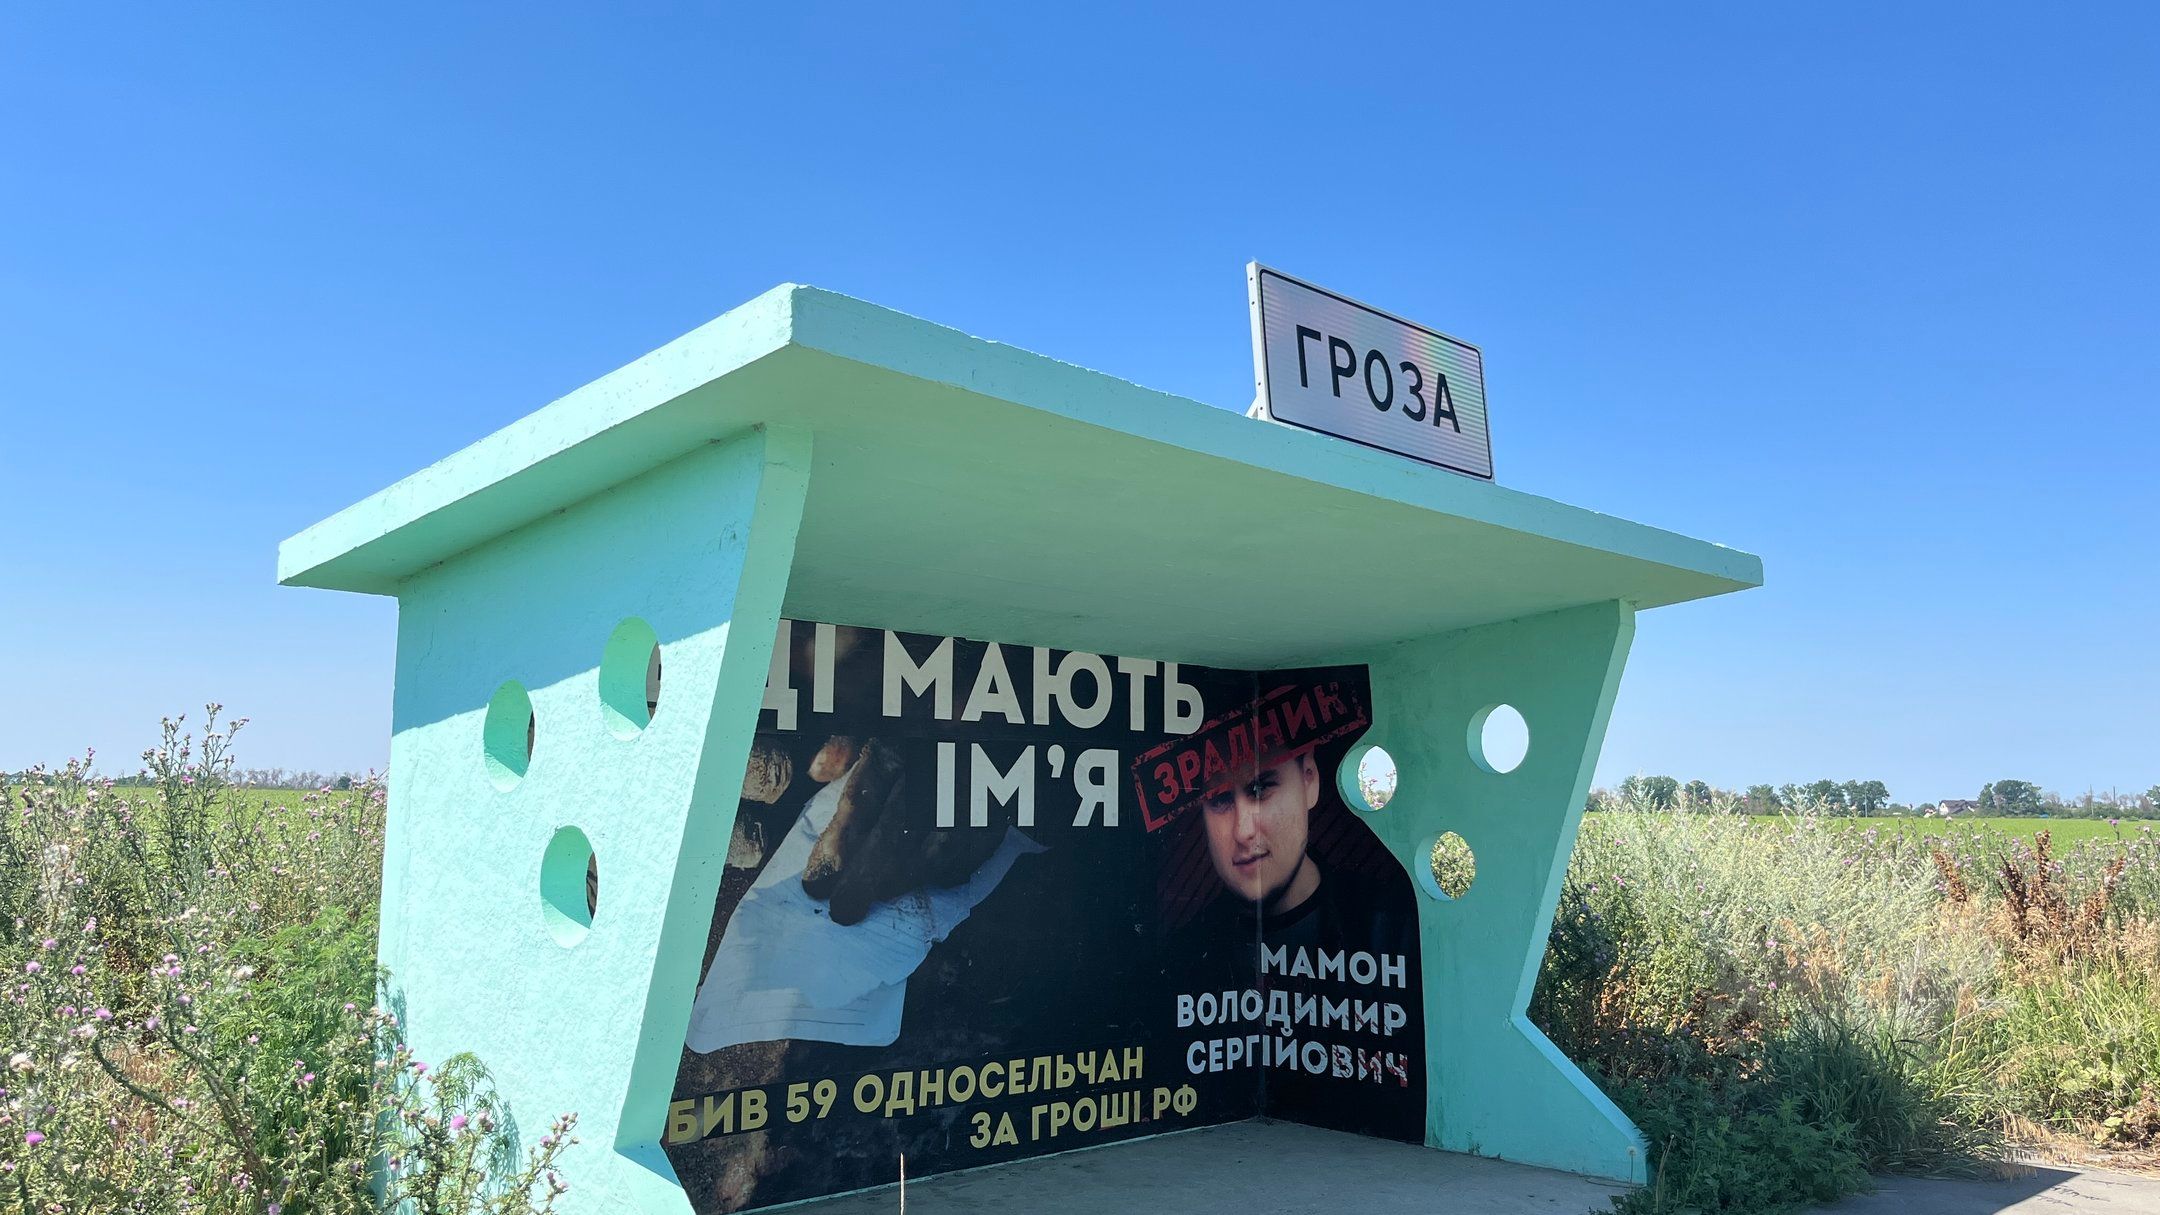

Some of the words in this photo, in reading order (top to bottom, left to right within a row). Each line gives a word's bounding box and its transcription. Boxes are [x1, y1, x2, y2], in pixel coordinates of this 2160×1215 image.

[1296, 324, 1461, 434] ГРОЗА
[882, 630, 1204, 736] МАЮТЬ
[1154, 681, 1348, 804] ЗРАДНИК
[1260, 942, 1406, 989] МАМОН
[1177, 989, 1407, 1037] ВОЛОДИМИР
[786, 1079, 837, 1124] 59
[853, 1046, 1144, 1118] ОДНОСЕЛЬЧАН
[1186, 1027, 1408, 1088] СЕРГІЙОВИЧ
[969, 1111, 1018, 1149] ЗА
[1031, 1090, 1140, 1141] ГРОШІ
[1153, 1084, 1197, 1119] РФ
